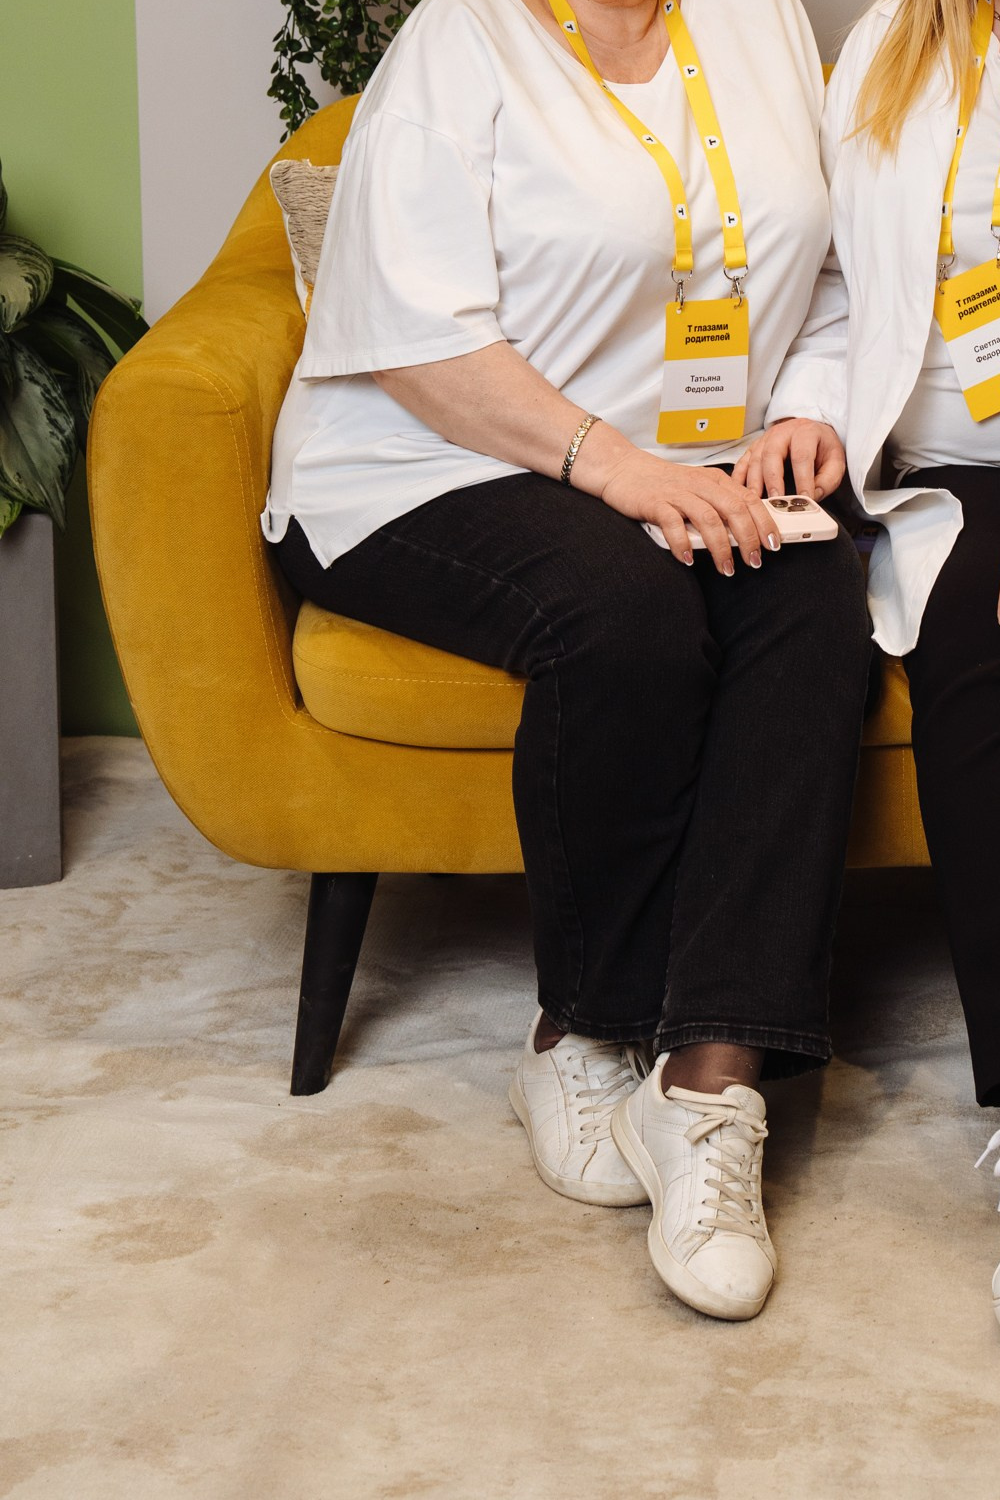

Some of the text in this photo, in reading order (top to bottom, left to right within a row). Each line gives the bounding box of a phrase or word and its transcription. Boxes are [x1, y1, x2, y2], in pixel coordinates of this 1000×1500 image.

[955, 284, 998, 308] Т глазами
[687, 323, 729, 333] Т глазами
[685, 332, 731, 346] родителей
[690, 374, 721, 383] Татьяна
[684, 385, 725, 394] Федорова
